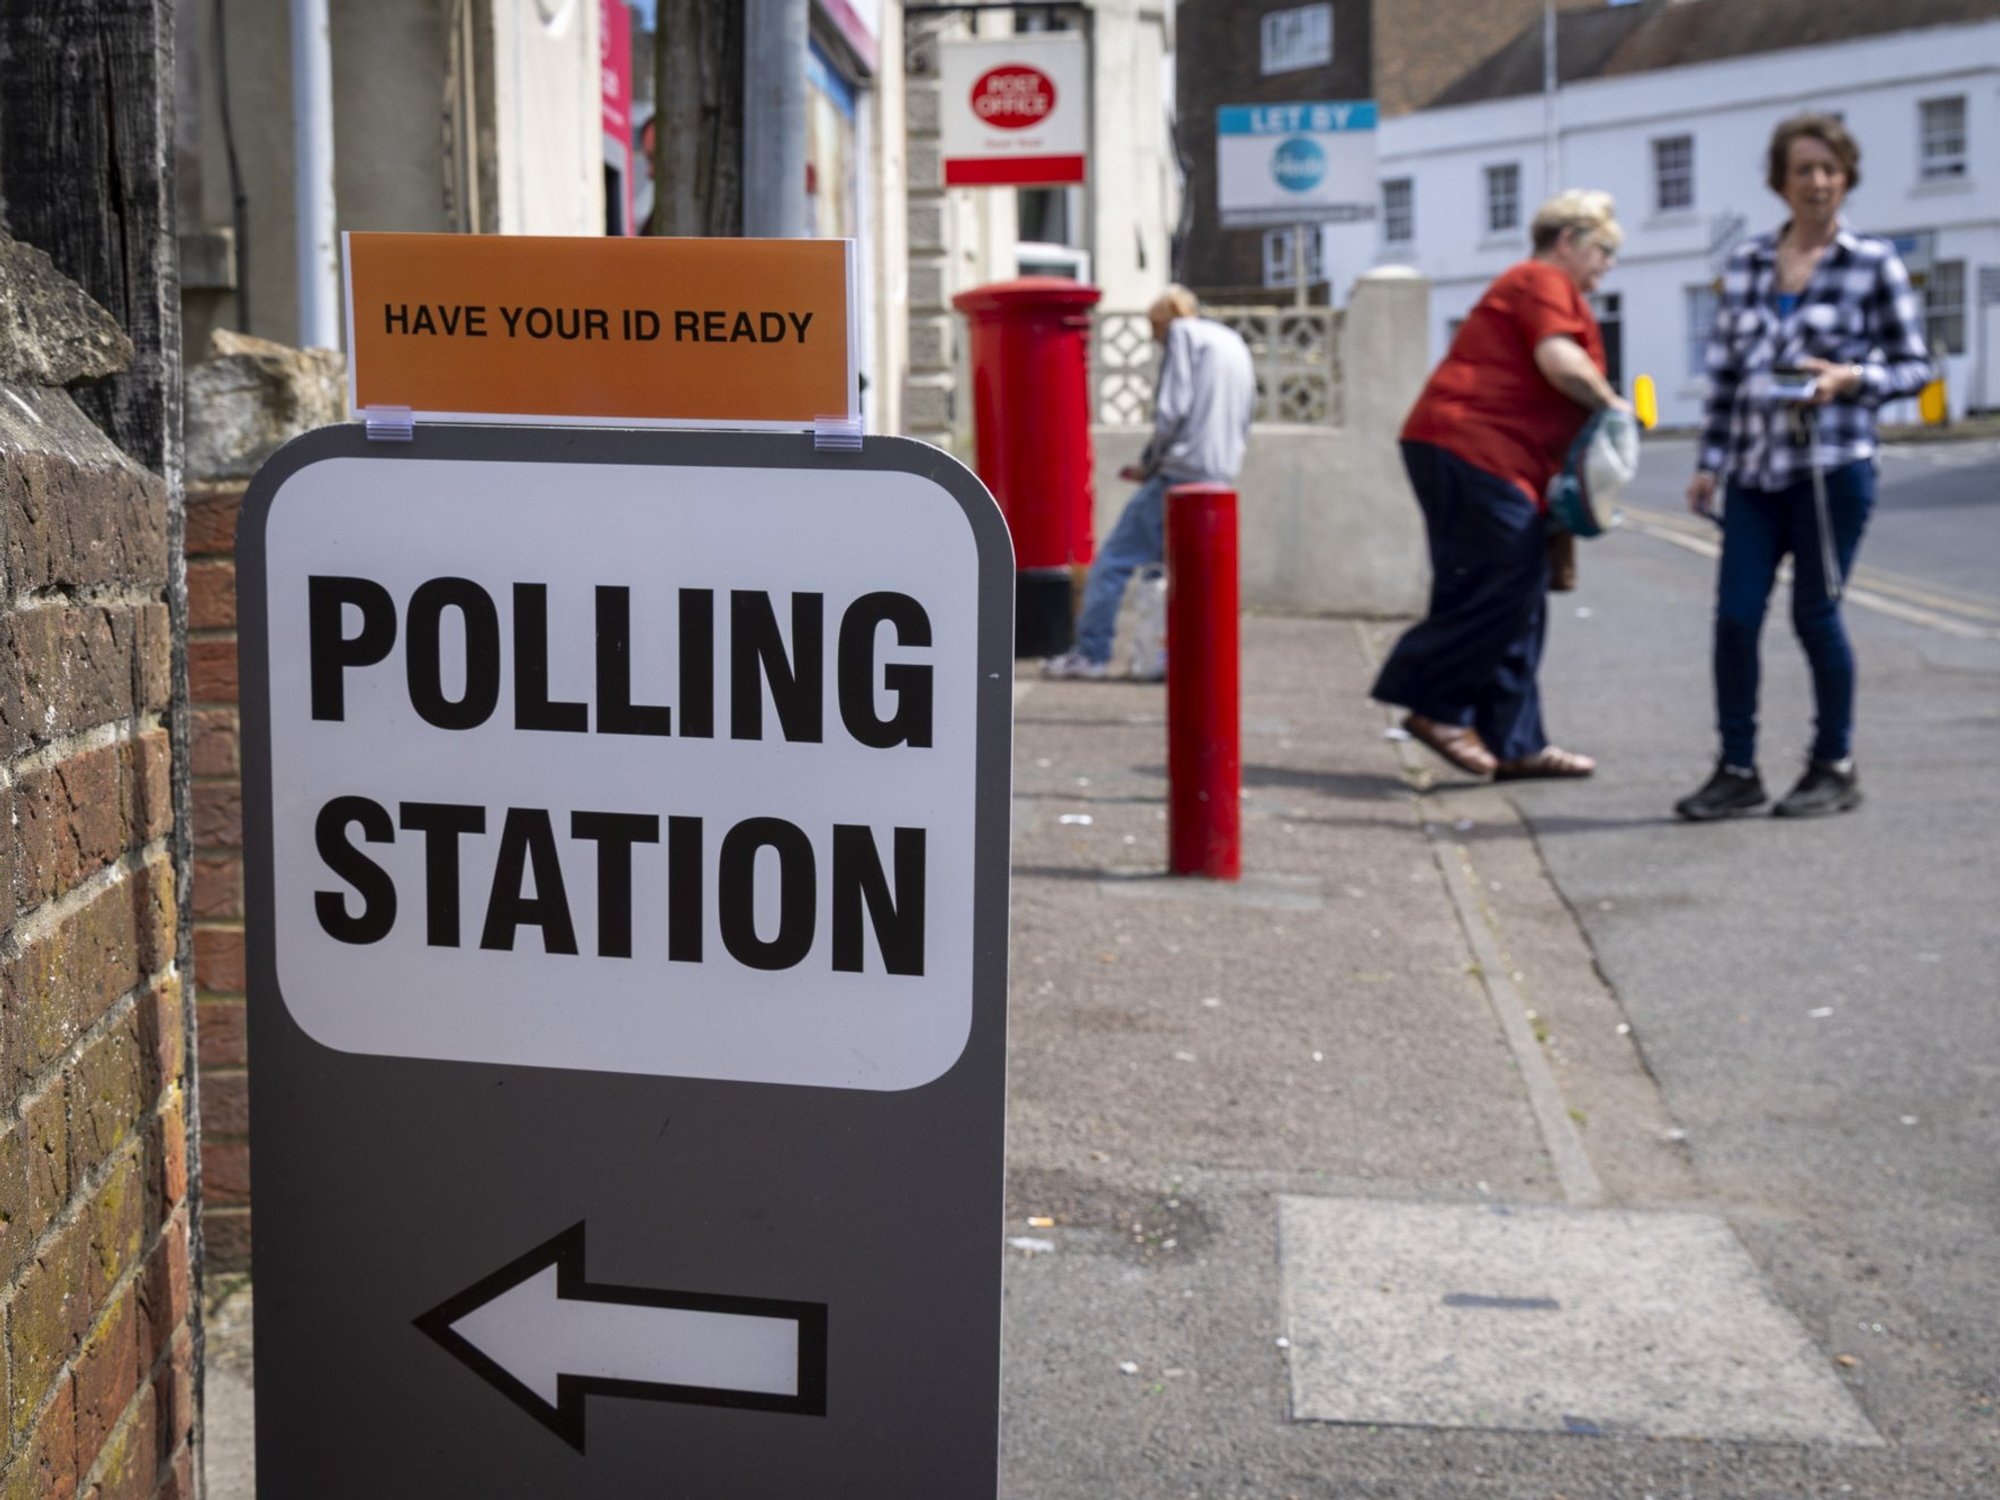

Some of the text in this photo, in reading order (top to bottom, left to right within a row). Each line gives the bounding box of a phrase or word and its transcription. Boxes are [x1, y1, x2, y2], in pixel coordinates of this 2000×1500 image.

[986, 74, 1040, 95] POST
[975, 92, 1049, 117] OFFICE
[1250, 102, 1354, 132] LET BY
[384, 303, 814, 344] HAVE YOUR ID READY
[308, 575, 934, 749] POLLING
[314, 795, 927, 977] STATION
